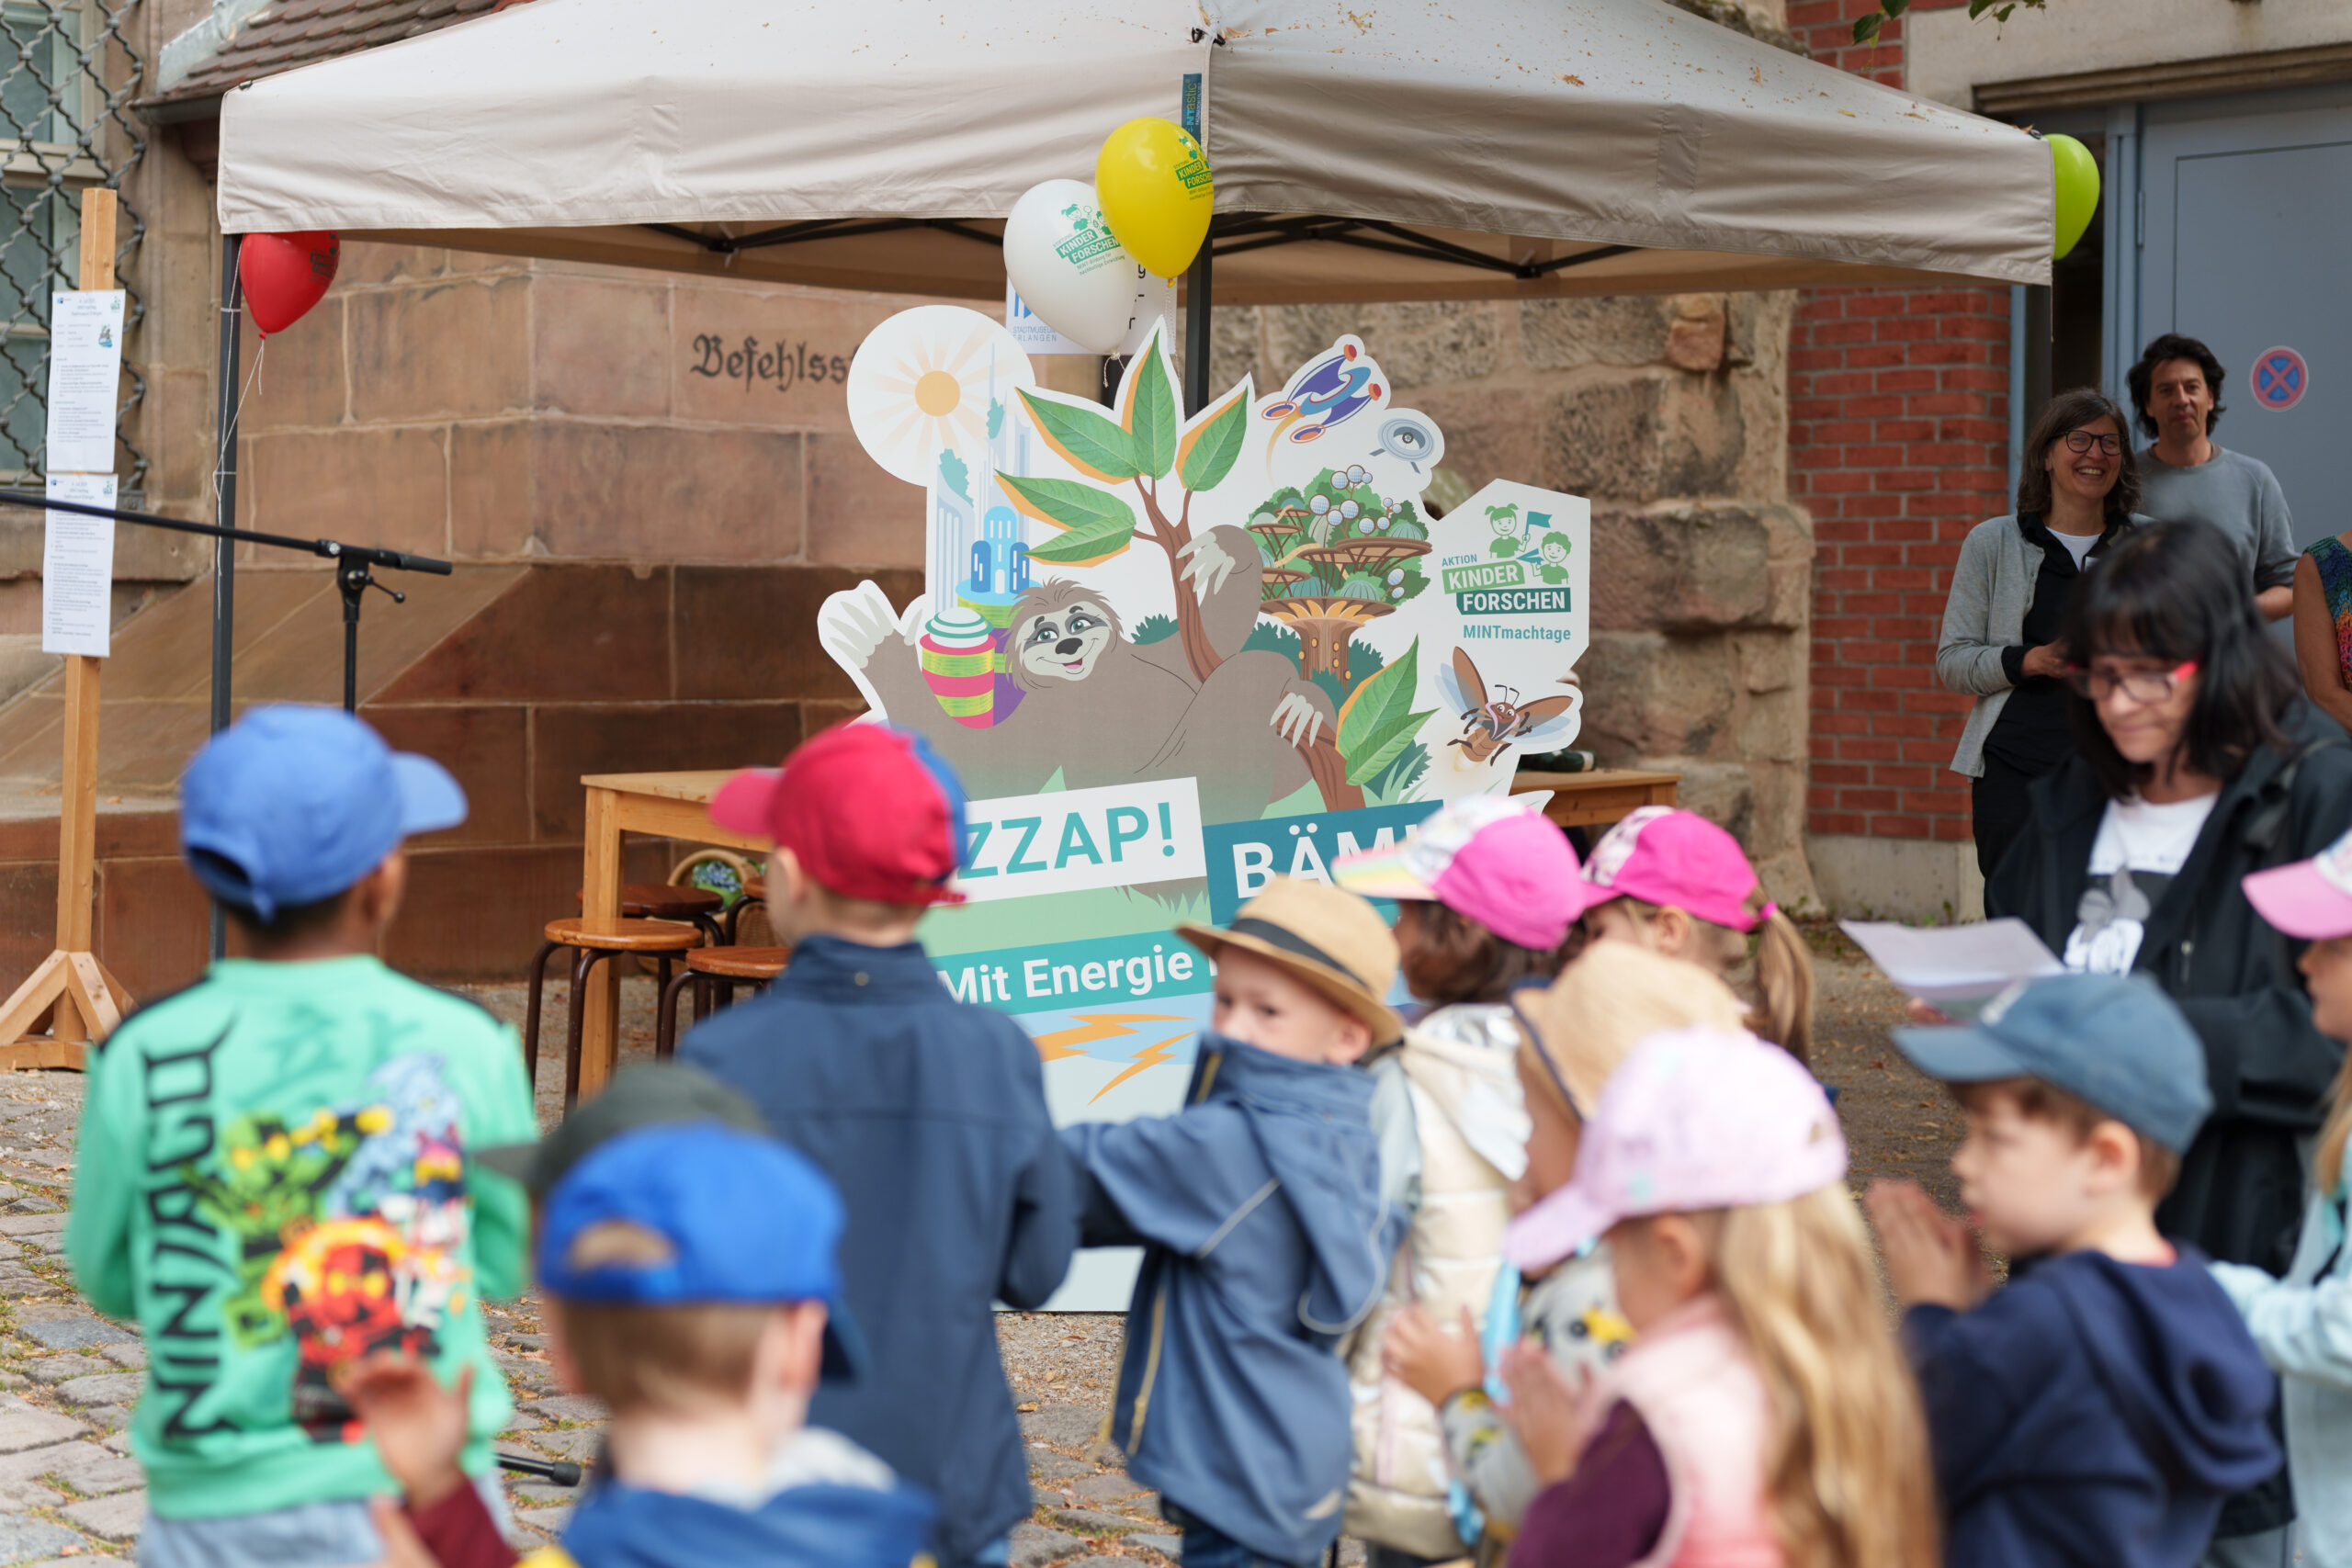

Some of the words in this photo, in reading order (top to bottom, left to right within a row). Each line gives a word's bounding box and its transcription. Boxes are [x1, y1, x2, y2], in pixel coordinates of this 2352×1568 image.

[1179, 162, 1203, 178] KINDER
[1059, 231, 1095, 255] KINDER
[1071, 237, 1119, 263] FORSCHEN
[689, 333, 860, 394] Befehlss
[1442, 554, 1477, 567] AKTION
[1449, 564, 1520, 591] KINDER
[1463, 591, 1566, 612] FORSCHEN
[1463, 625, 1571, 644] MINTmachtage
[940, 964, 1011, 1005] Mit
[1023, 943, 1193, 997] Energie
[143, 1010, 240, 1438] NINJAGO
